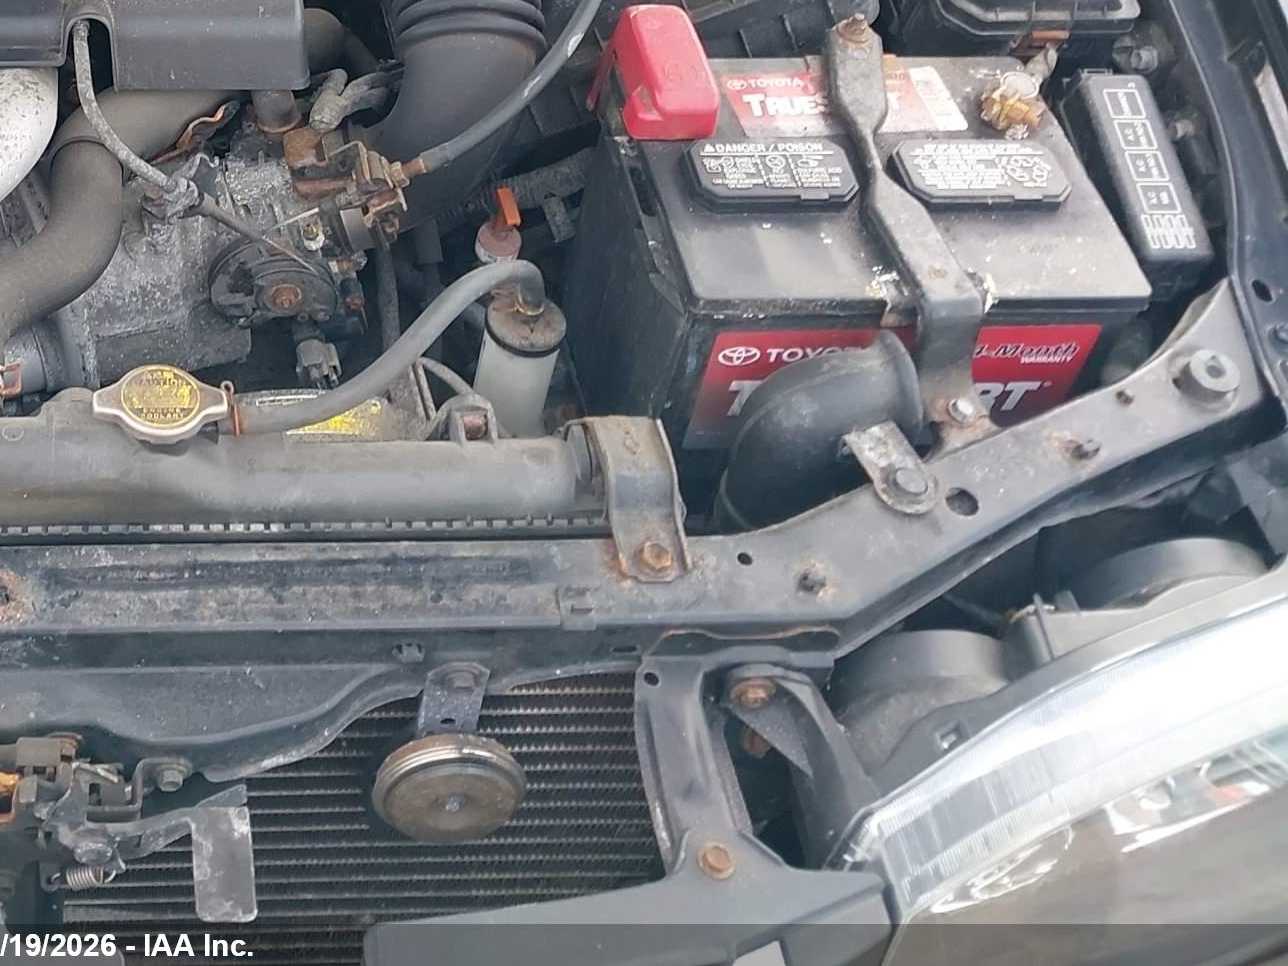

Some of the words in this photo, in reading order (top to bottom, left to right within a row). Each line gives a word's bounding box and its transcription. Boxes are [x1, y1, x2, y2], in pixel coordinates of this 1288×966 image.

[748, 77, 804, 88] TOYOTA
[715, 143, 765, 153] DANGER
[777, 141, 823, 152] POISON
[1020, 355, 1073, 364] WARRANTY
